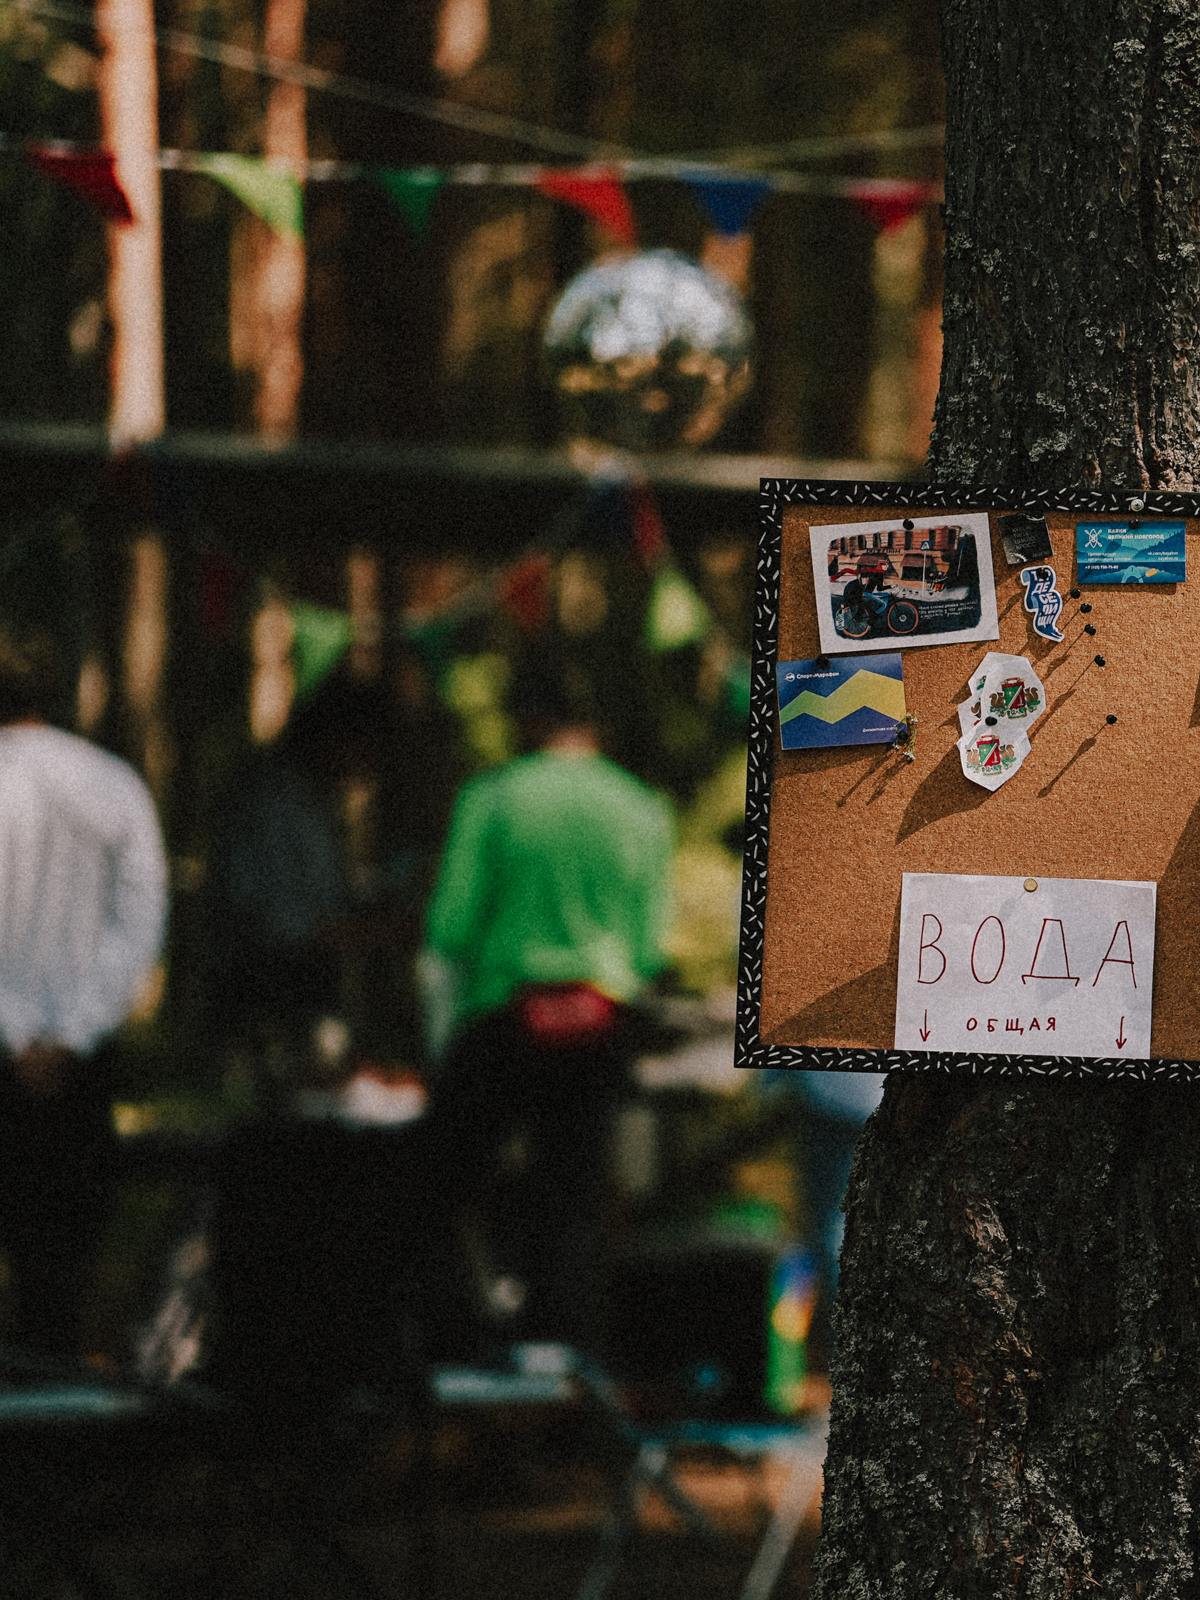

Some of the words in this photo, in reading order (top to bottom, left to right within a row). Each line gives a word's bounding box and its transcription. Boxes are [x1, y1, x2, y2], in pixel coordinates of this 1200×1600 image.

[796, 671, 840, 680] Спорт-Марафон
[917, 913, 1138, 989] ВОДА
[966, 1017, 1057, 1036] ОБЩАЯ
